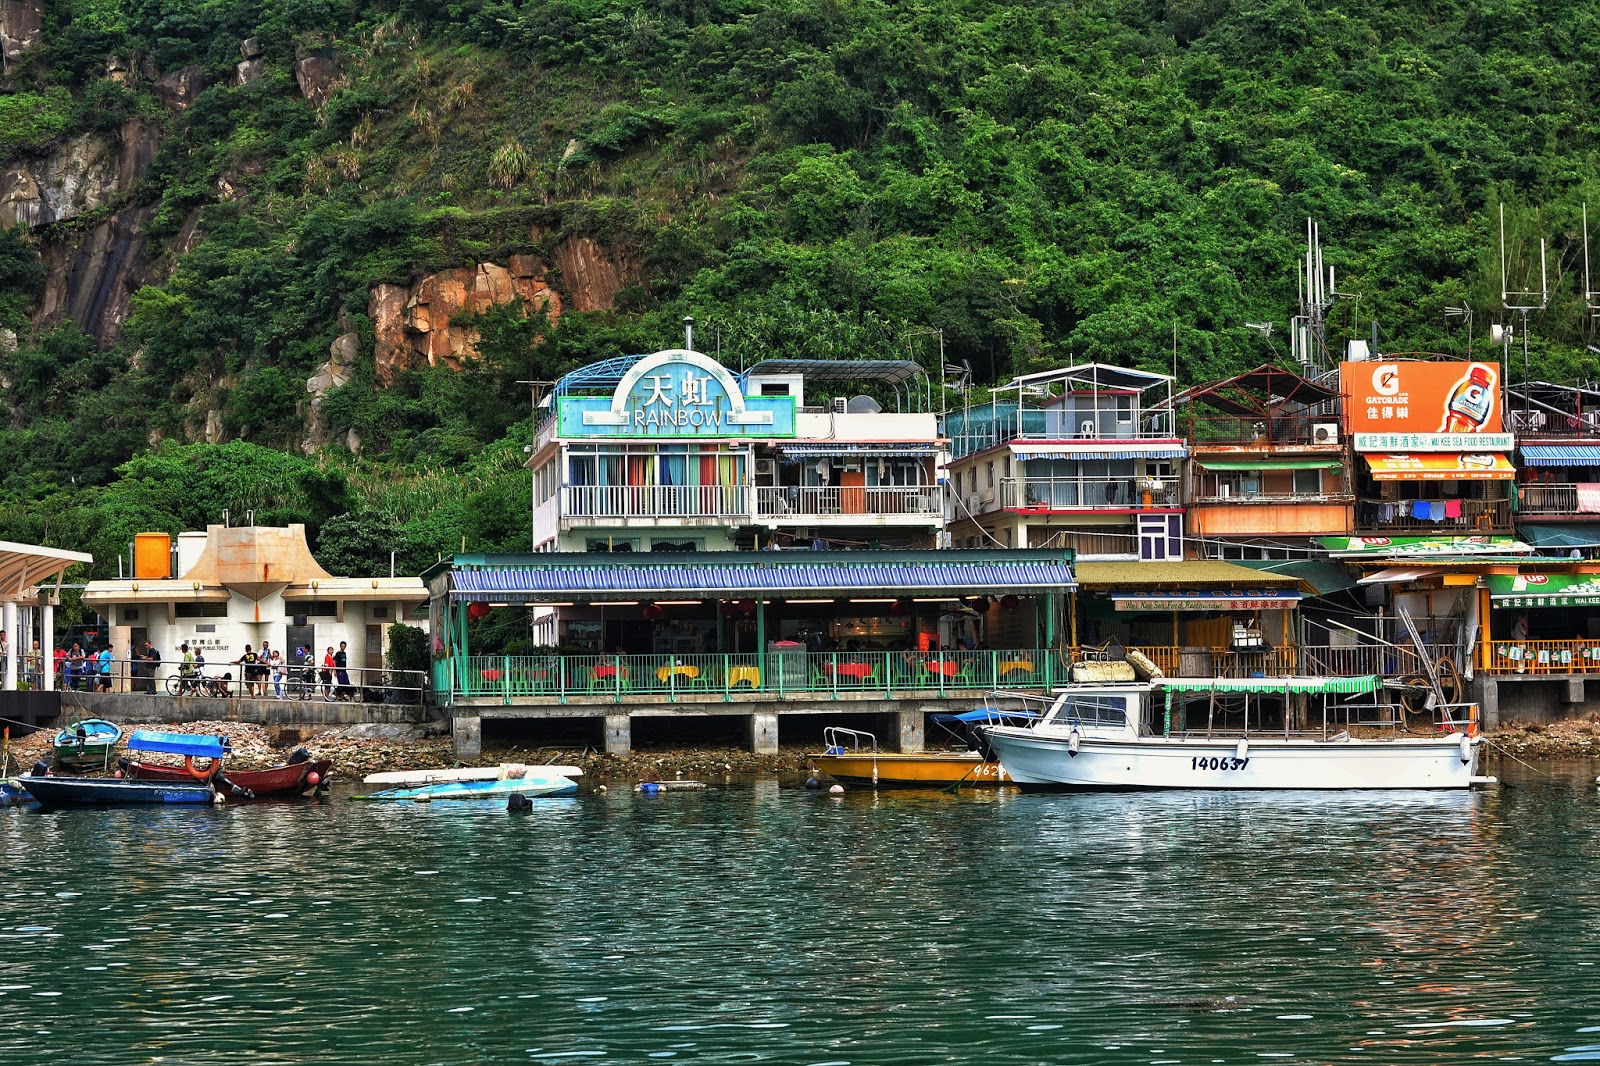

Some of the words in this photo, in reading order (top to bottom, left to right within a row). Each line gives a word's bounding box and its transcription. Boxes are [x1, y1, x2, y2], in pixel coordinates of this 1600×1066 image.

[1372, 365, 1399, 396] G
[643, 371, 713, 407] 天虹
[634, 410, 722, 426] RAINBOW
[1367, 407, 1409, 419] 佳得樂
[1358, 434, 1420, 448] 威記海鮮酒家
[1431, 437, 1439, 447] WAI
[1440, 437, 1450, 447] KEE
[1453, 437, 1463, 447] SEA
[1465, 437, 1477, 447] FOOD
[1479, 436, 1510, 447] RESTAURANT
[1192, 757, 1249, 770] 140637
